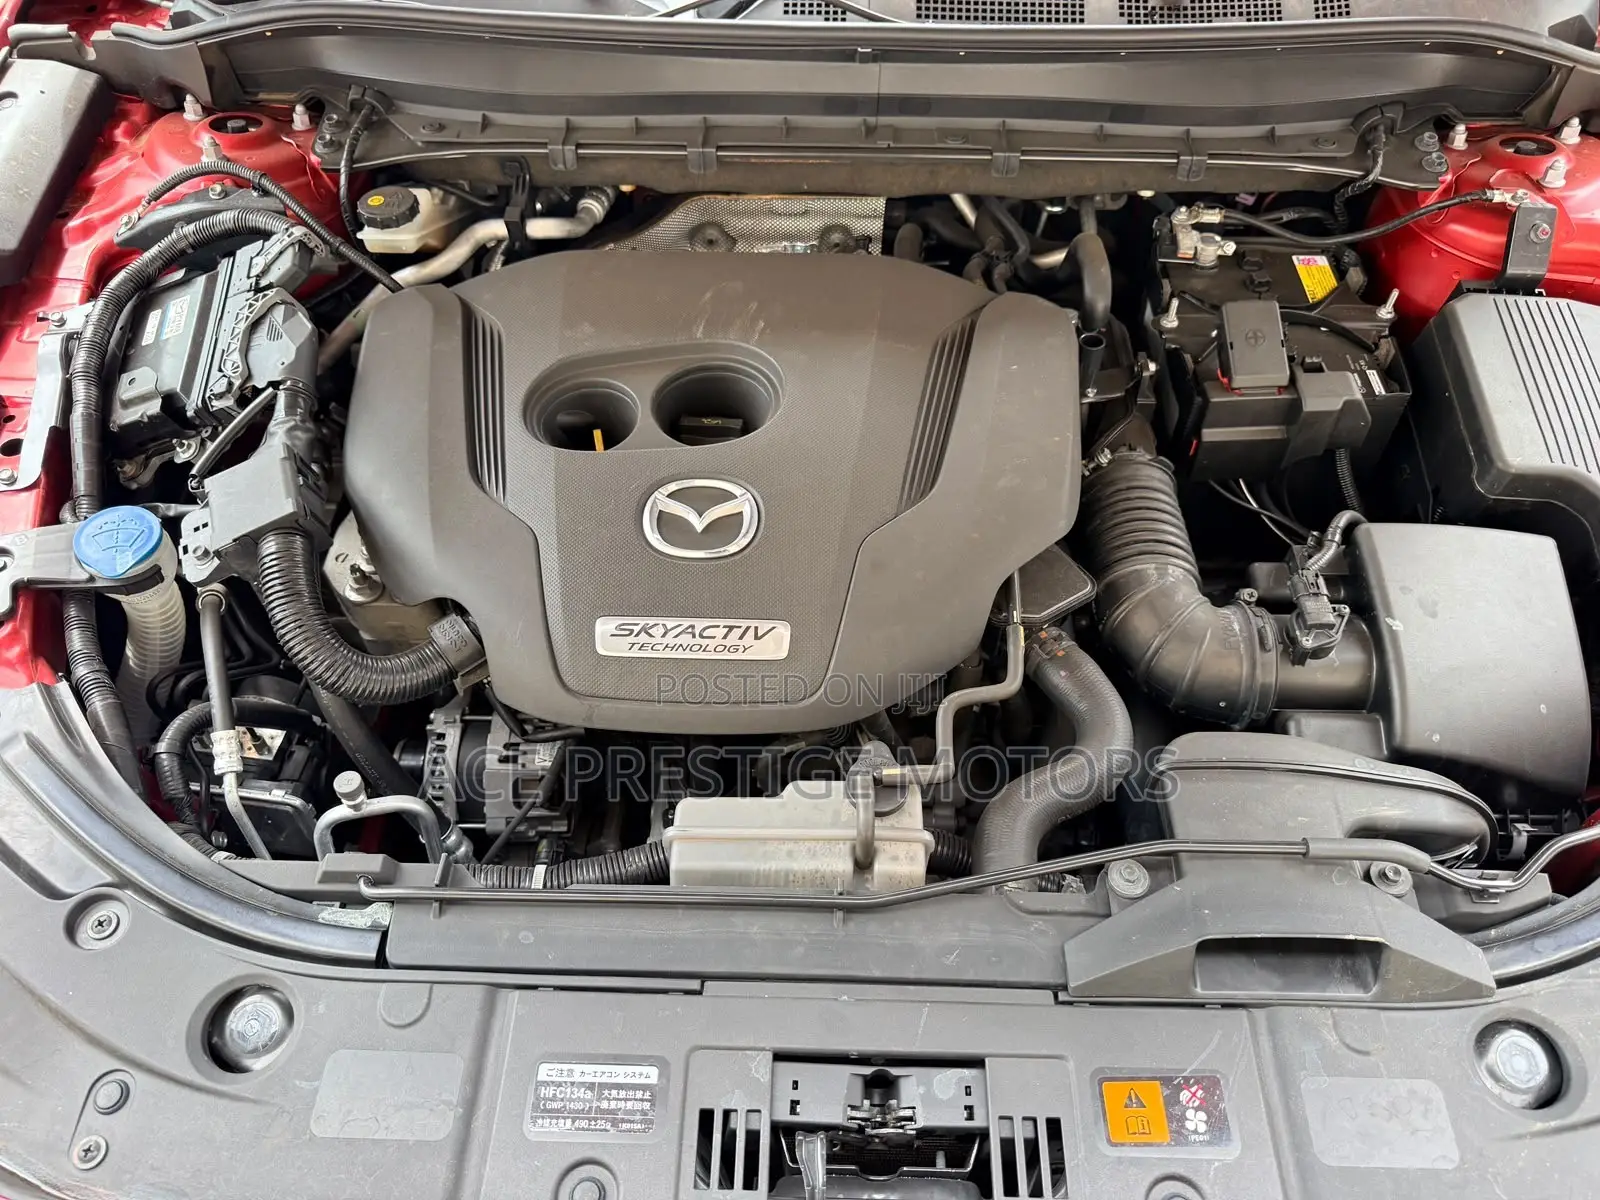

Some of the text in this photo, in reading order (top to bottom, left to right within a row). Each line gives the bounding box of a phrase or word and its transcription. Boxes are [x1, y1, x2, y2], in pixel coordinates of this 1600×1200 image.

[609, 622, 778, 641] SKYACTIV
[627, 642, 754, 654] TECHNOLOGY
[540, 1086, 592, 1099] HFC134a
